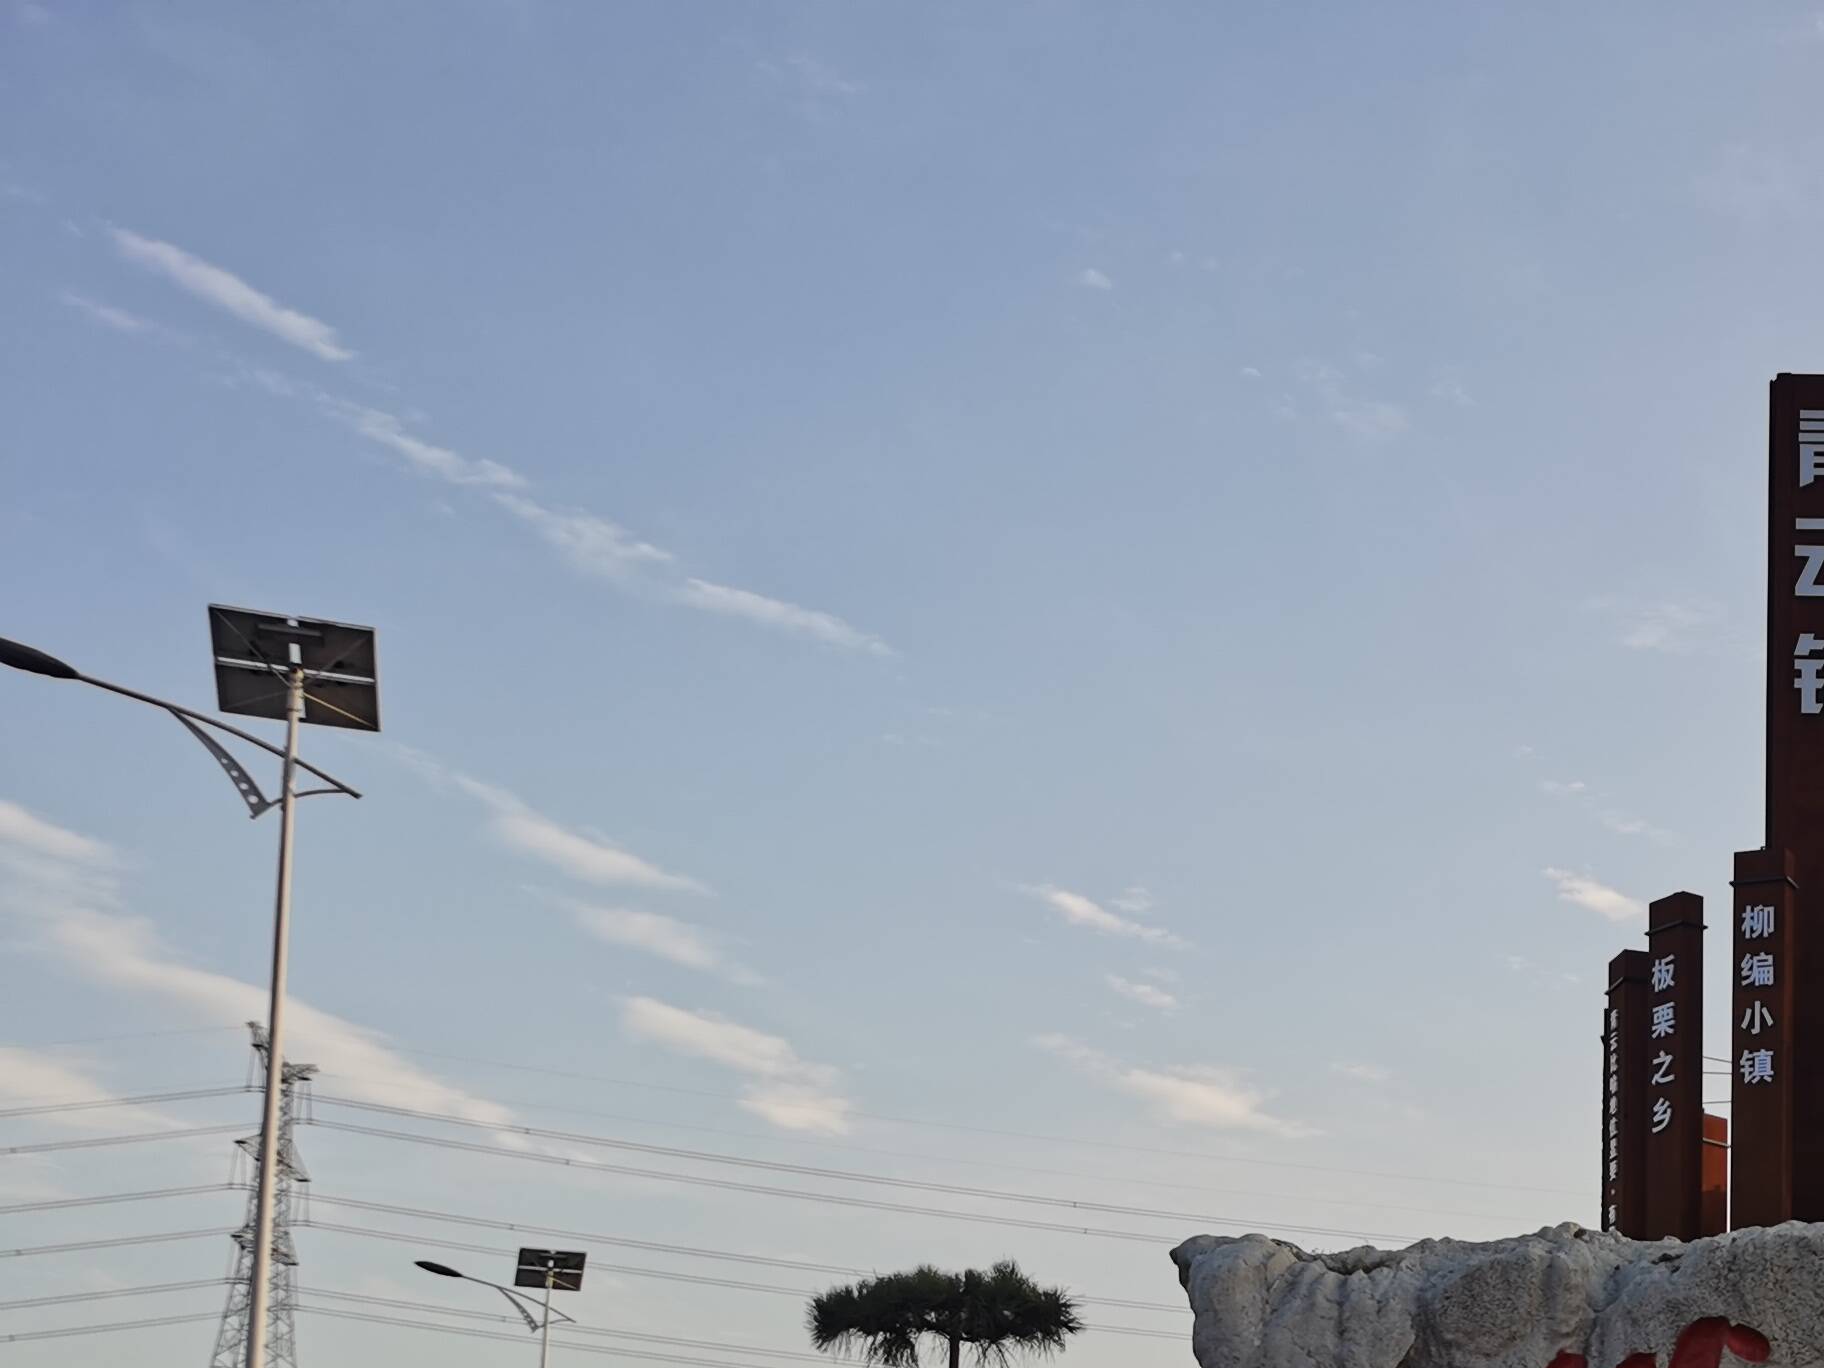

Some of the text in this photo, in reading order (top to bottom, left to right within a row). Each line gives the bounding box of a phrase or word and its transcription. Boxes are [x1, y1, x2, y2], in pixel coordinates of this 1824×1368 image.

[1651, 953, 1676, 1134] 板栗之乡
[1740, 904, 1775, 1084] 柳编小镇
